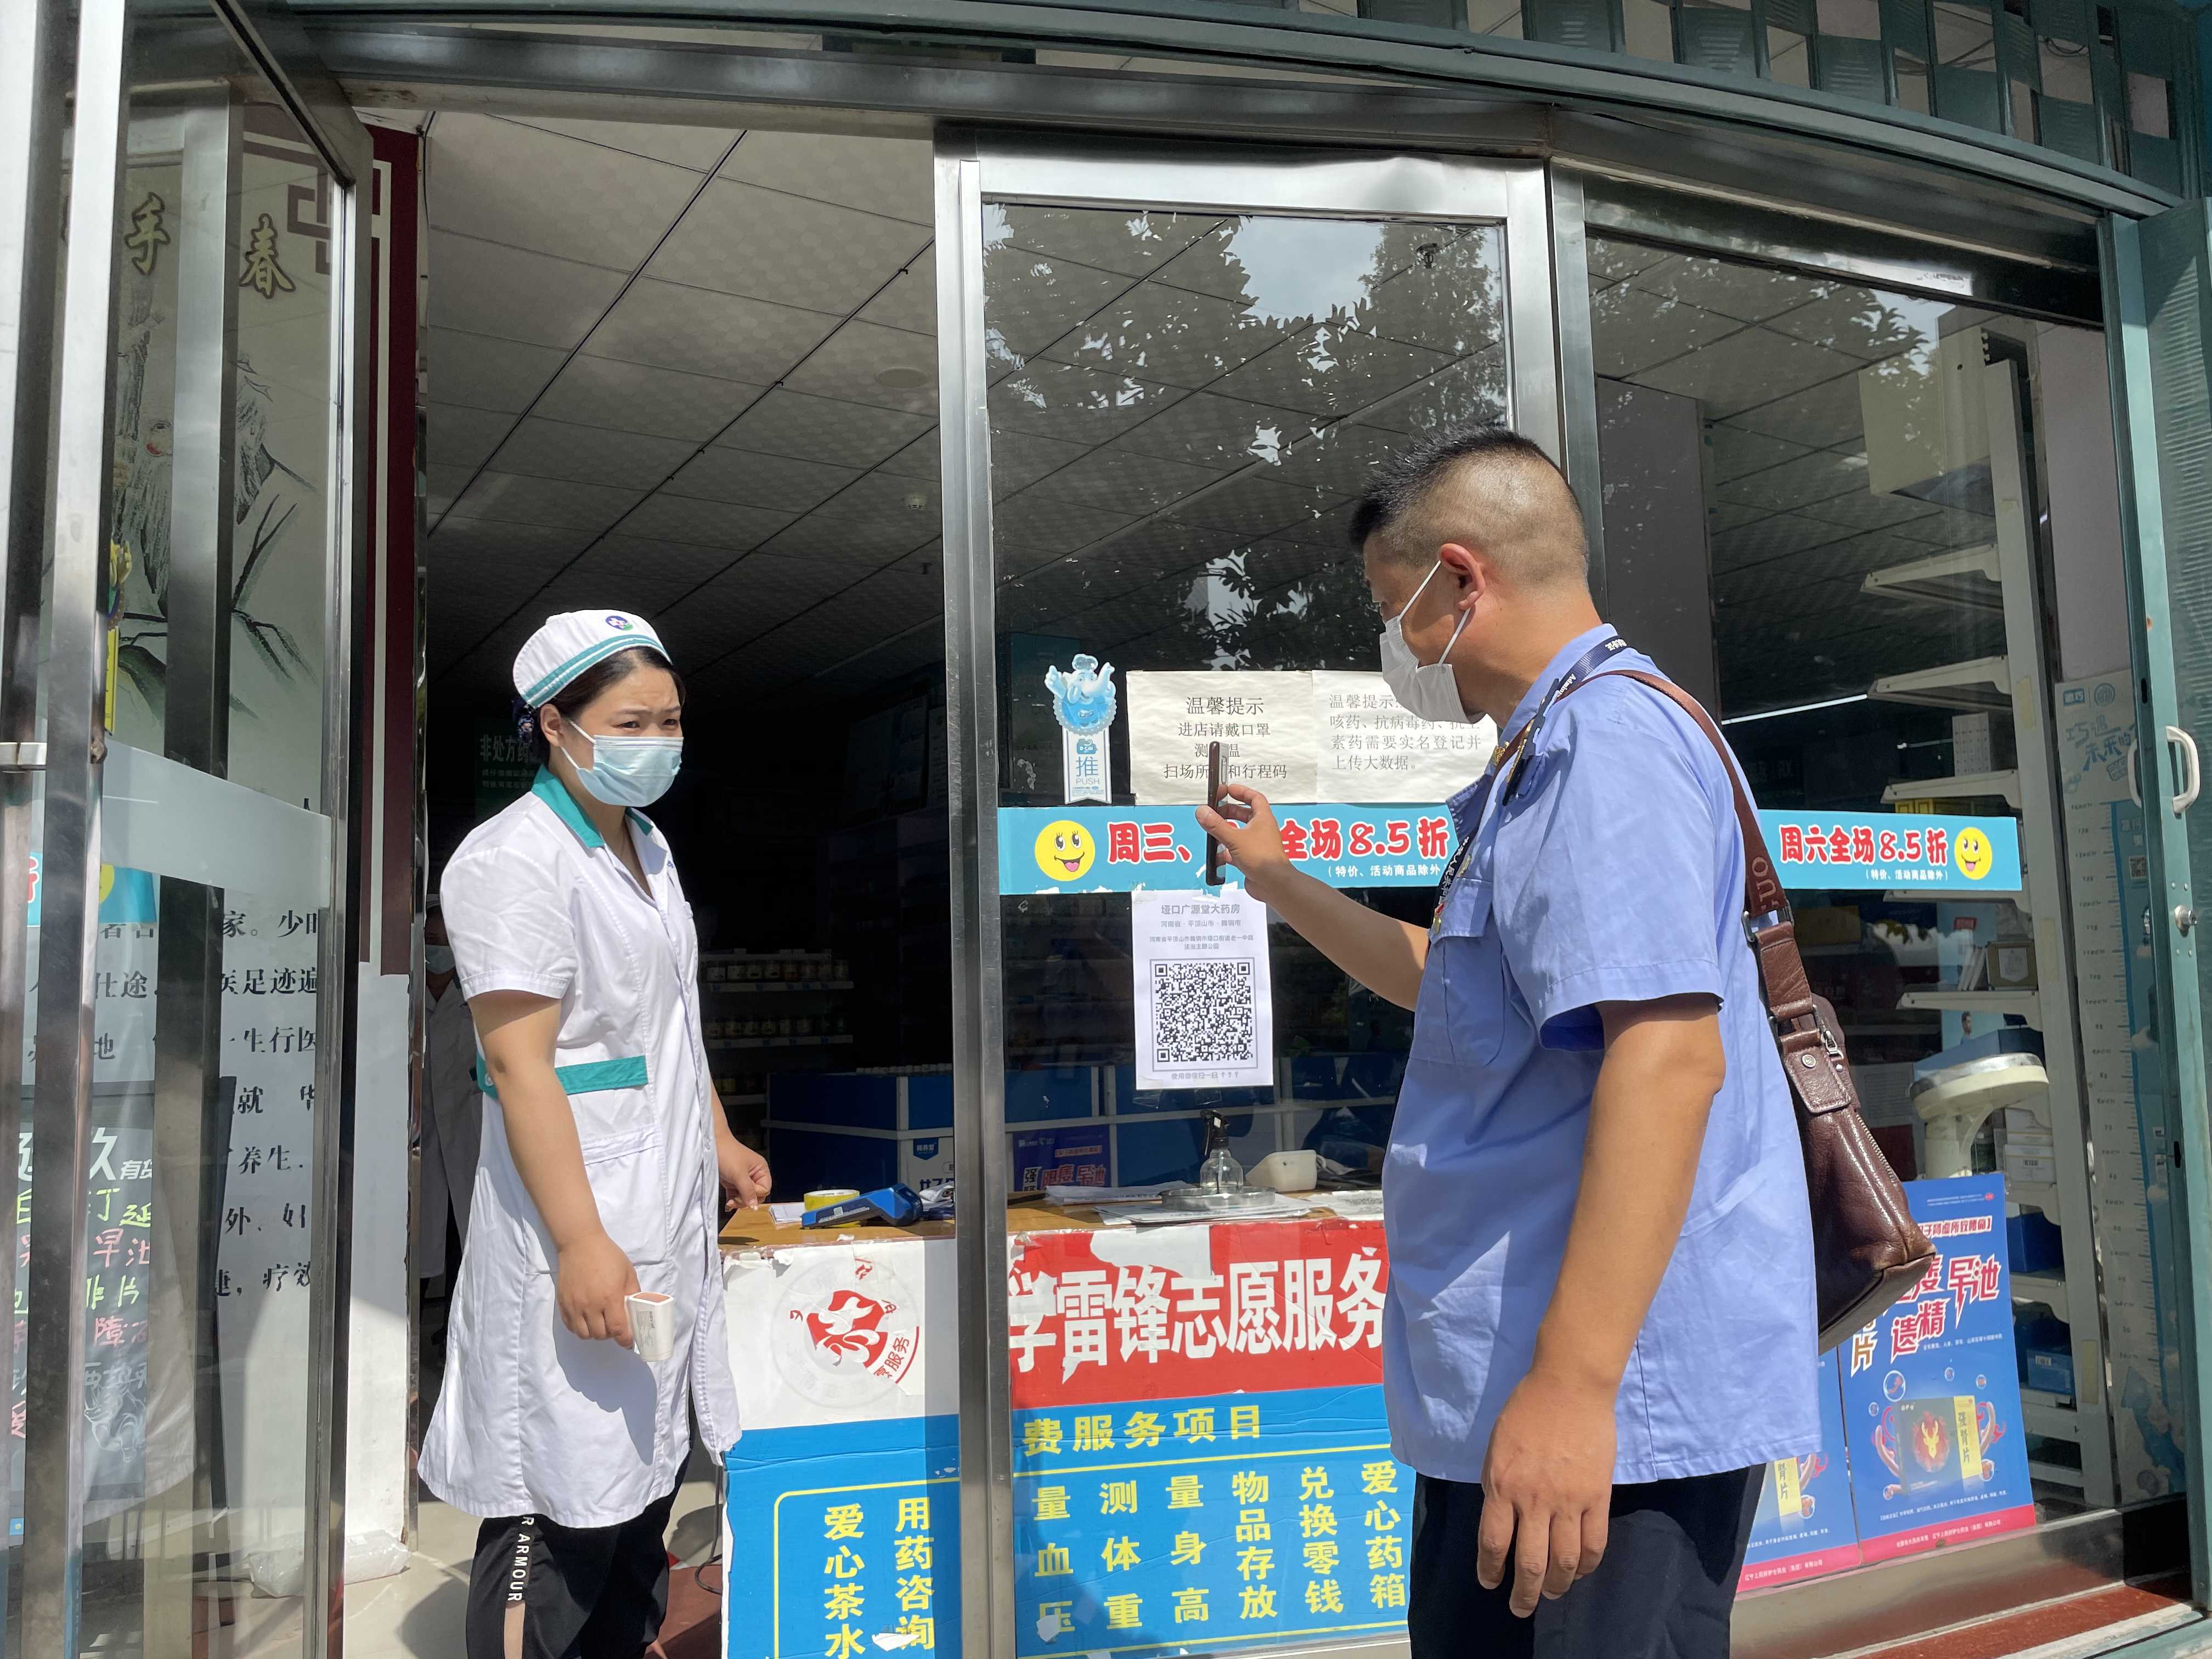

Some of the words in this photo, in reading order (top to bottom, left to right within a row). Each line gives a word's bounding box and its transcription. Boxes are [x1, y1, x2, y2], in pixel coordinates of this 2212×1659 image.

[238, 213, 295, 299] 春
[1178, 723, 1271, 737] 进店请戴口罩
[1186, 697, 1264, 715] 温馨提示
[1075, 756, 1099, 777] 推
[1164, 763, 1287, 780] 扫场所和行程码
[1194, 743, 1240, 758] 测温
[1330, 734, 1482, 750] 素药需要实名登记并
[1076, 777, 1100, 786] PUSH
[1779, 824, 1948, 866] 周六全场8.5折
[1161, 904, 1241, 915] 垭口广源堂大药房
[507, 1533, 531, 1602] ARMOUR
[1032, 1485, 1075, 1633] 量血压
[1100, 1480, 1143, 1630] 测体重
[1165, 1474, 1210, 1623] 量身高
[1232, 1470, 1278, 1620] 物品存放
[1299, 1466, 1344, 1614] 兑换零钱
[1361, 1459, 1407, 1609] 爱心药箱
[823, 1502, 866, 1659] 爱心茶水
[894, 1496, 935, 1651] 用药咨询
